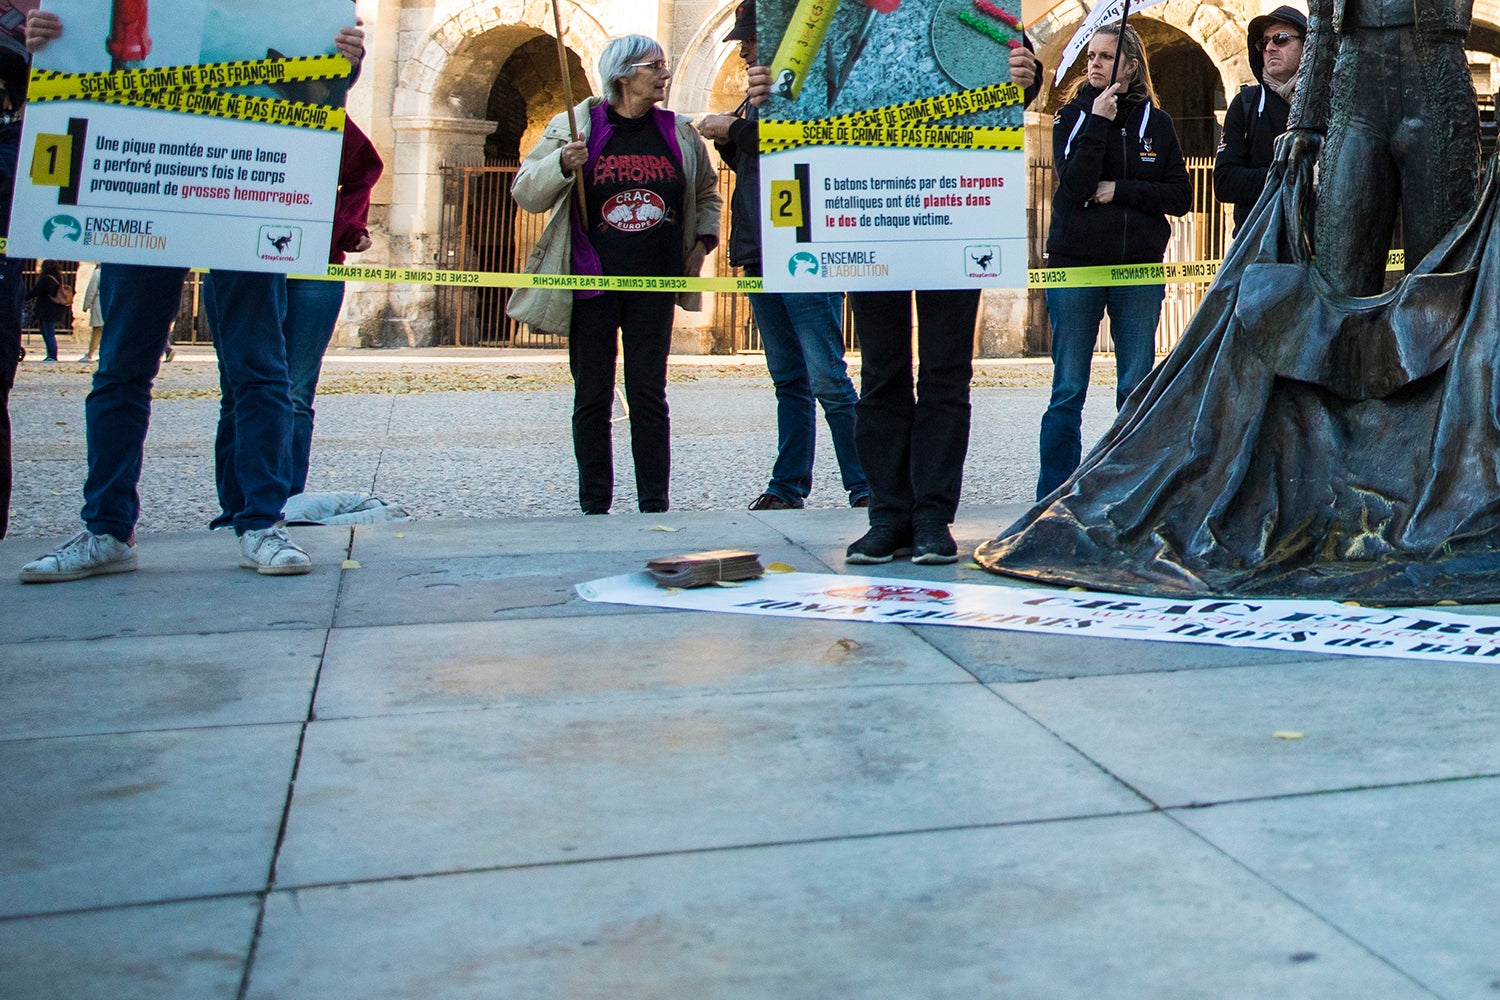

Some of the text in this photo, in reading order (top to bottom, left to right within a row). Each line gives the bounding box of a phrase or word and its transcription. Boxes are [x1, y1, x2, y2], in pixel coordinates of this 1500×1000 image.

[80, 63, 286, 94] SCENE DE CRIME NE PAS FRANCHIR
[167, 92, 329, 125] DE CRIME NE PAS FRANCHIR
[885, 87, 1019, 124] DE CRIME NE PAS FRANCHIR
[803, 127, 973, 144] SCENE DE CRIME NE PAS FRANCHIR
[96, 135, 287, 164] Une pique montée sur une lance
[46, 144, 58, 175] 1
[597, 153, 676, 171] CORRIDA
[93, 157, 286, 185] a perforé pusieurs fois le corps
[594, 165, 677, 185] LA HONTE
[90, 178, 313, 207] provoquant de grosses hemorragies.
[824, 175, 1004, 193] 6 batons terminés par des harpons
[615, 190, 651, 205] CRAC
[779, 190, 793, 217] 2
[825, 194, 991, 212] métalliques ont été plantés dans
[85, 217, 153, 235] ENSEMBLE
[617, 220, 651, 231] EUROPE
[825, 213, 953, 230] le dos de chaque victime.
[93, 232, 167, 250] L'ABOLITION
[821, 251, 876, 265] ENSEMBLE
[829, 264, 889, 277] L'ABOLITION
[1022, 597, 1263, 616] CRAC
[1324, 637, 1394, 649] de
